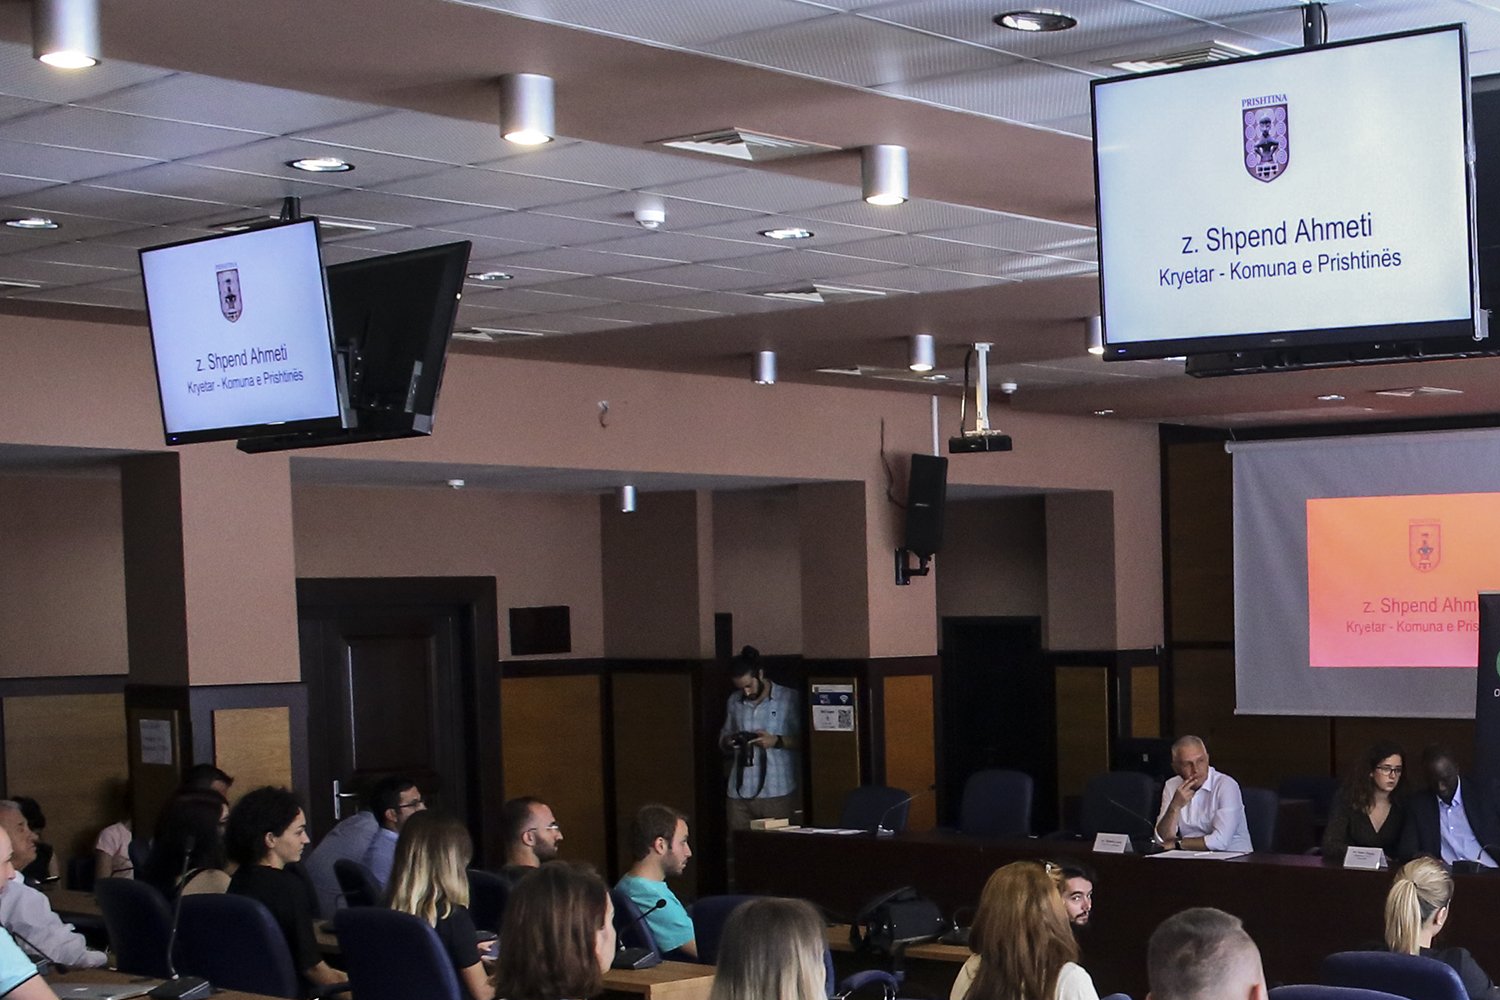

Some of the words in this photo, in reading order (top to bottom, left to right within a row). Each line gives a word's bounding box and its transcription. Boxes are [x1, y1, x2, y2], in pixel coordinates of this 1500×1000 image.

[1241, 94, 1288, 109] PRISHTINA
[1181, 236, 1199, 254] z.
[1206, 220, 1287, 255] Shpend
[1294, 212, 1373, 243] Ahmeti
[1159, 267, 1215, 290] Kryetar
[1230, 261, 1297, 280] Komuna
[1302, 260, 1312, 274] e
[1318, 248, 1402, 273] Prishtinës
[207, 349, 248, 373] Shpend
[251, 343, 288, 365] Ahmeti
[187, 381, 215, 396] Kryetar
[221, 376, 255, 390] Komuna
[1363, 601, 1376, 614] z.
[1380, 597, 1438, 616] Shpend
[1346, 620, 1386, 636] Kryetar
[1396, 620, 1444, 632] Komuna
